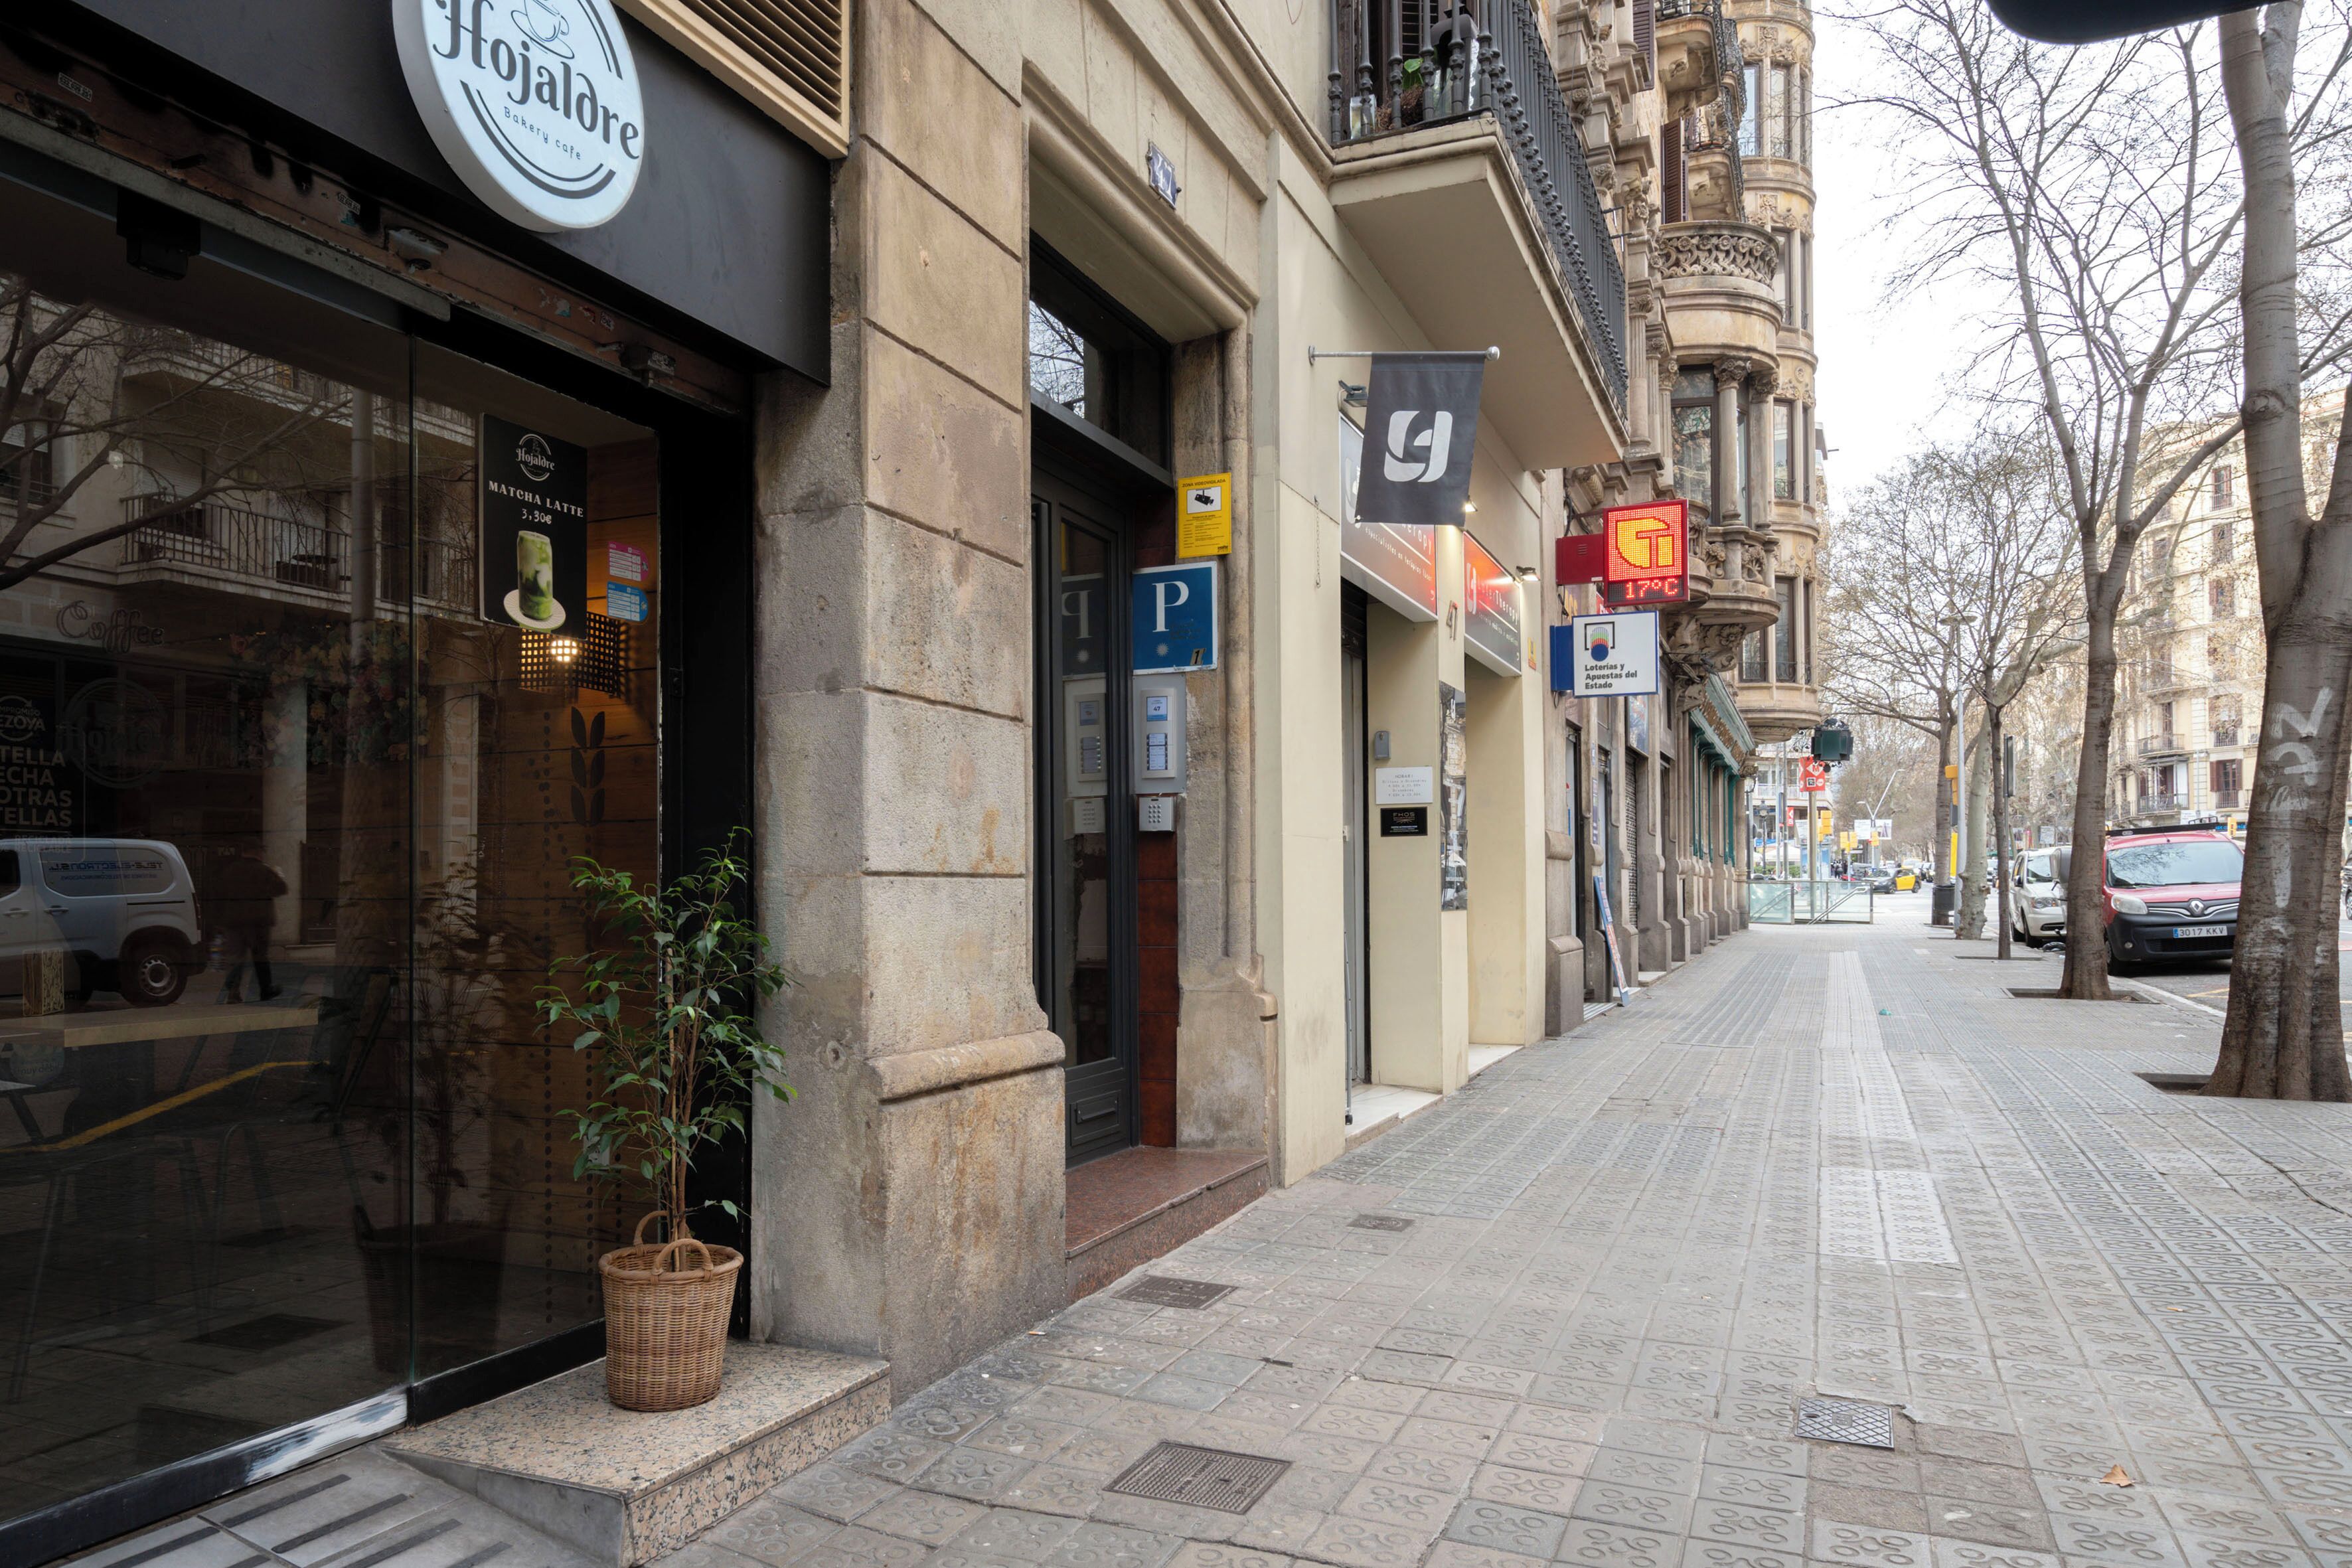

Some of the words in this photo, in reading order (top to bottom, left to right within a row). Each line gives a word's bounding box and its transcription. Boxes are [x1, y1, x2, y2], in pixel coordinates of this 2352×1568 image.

[432, 0, 640, 159] Hojaldre
[504, 106, 548, 143] Bakery
[556, 139, 581, 159] cafe
[515, 447, 555, 470] Hojaldre
[489, 480, 542, 505] MATCHA
[546, 498, 584, 517] LATTE
[1152, 580, 1189, 633] P
[56, 599, 165, 654] Coffee
[1585, 663, 1618, 671] Loterías
[1585, 671, 1623, 681] Apuestas
[1585, 681, 1612, 690] Estado
[0, 806, 72, 828] ELLAS
[2179, 928, 2203, 937] 3017
